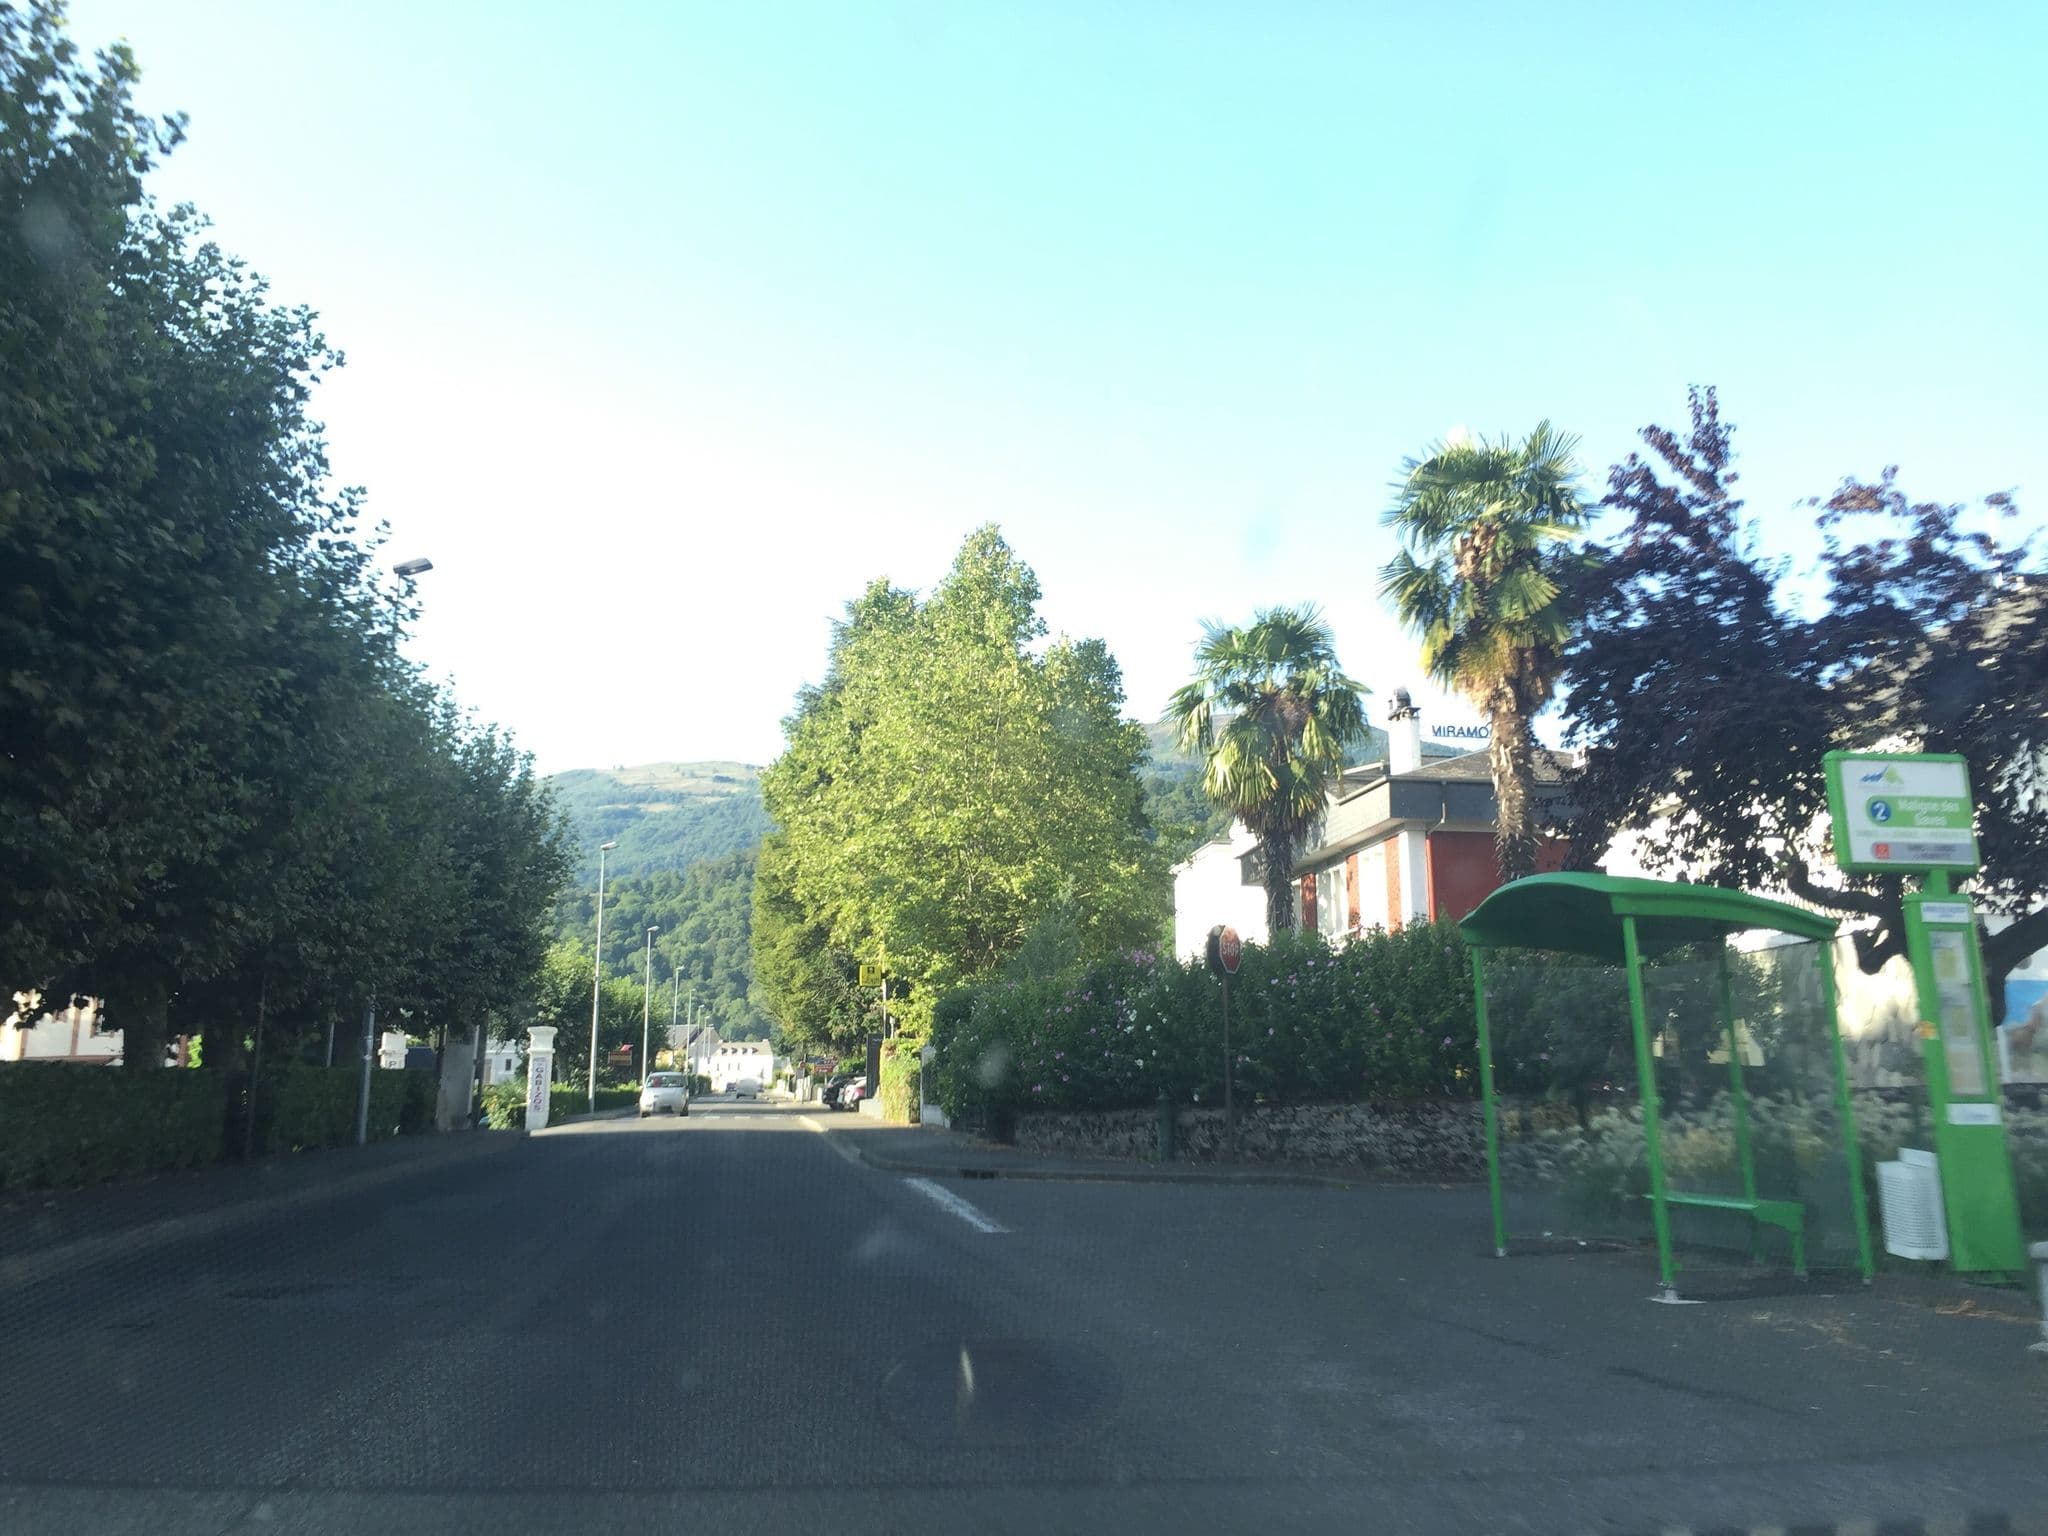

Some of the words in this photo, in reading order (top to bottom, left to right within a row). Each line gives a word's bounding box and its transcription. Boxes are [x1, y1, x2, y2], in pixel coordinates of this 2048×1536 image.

[1432, 725, 1491, 738] MIRAMO
[1873, 803, 1887, 820] 2
[1222, 943, 1239, 956] STOP
